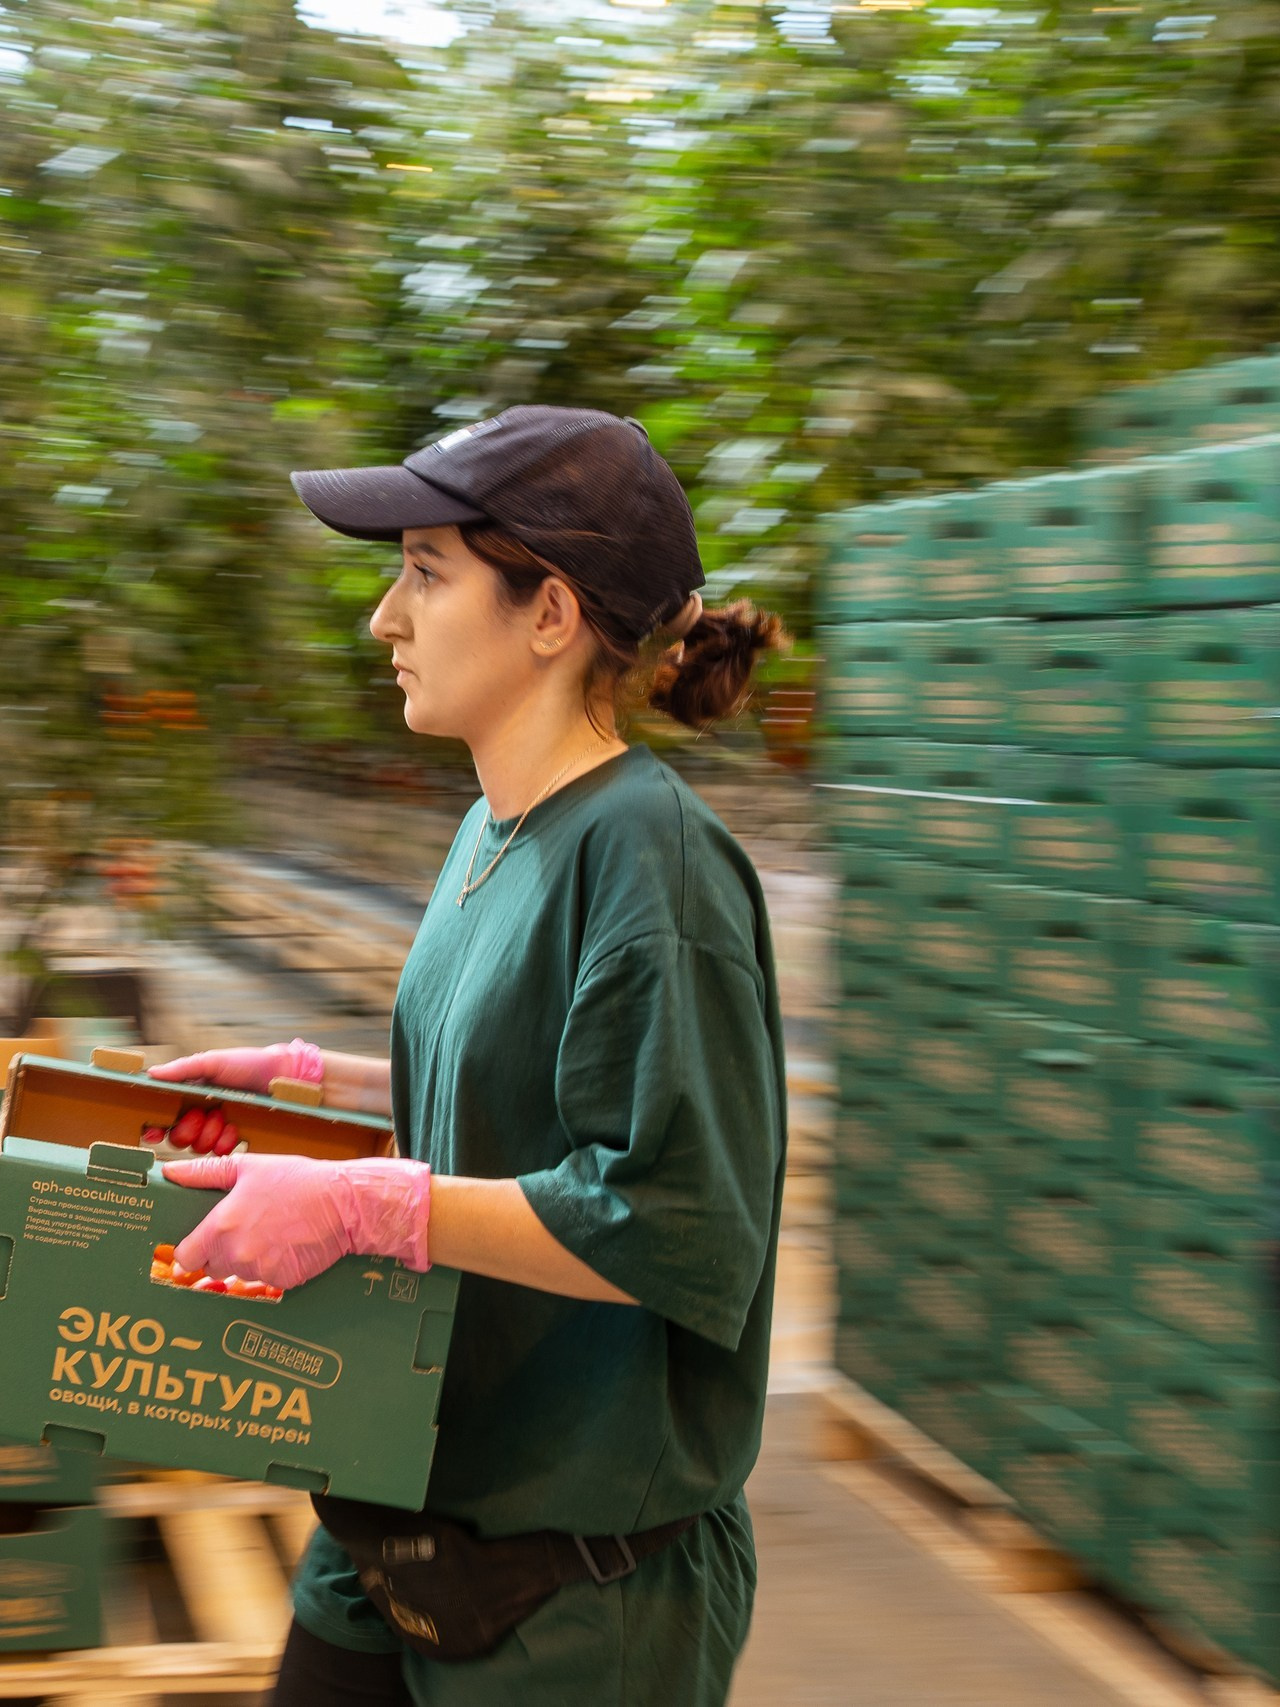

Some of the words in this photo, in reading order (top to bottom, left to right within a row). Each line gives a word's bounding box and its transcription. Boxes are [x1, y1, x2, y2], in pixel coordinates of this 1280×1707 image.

[32, 1180, 154, 1209] aph-ecoculture.ru
[28, 1205, 68, 1218] Выращено
[74, 1214, 123, 1228] защищенном
[123, 1222, 148, 1232] грунте
[30, 1196, 57, 1207] Страна
[118, 1210, 152, 1222] РОССИЯ
[24, 1223, 81, 1238] рекомендуется
[81, 1233, 100, 1241] мыть
[26, 1215, 50, 1226] Перед
[51, 1220, 108, 1235] употреблением
[23, 1232, 34, 1240] Не
[34, 1235, 70, 1246] содержит
[71, 1240, 90, 1249] ГМО
[51, 1346, 313, 1426] КУЛЬТУРА
[49, 1387, 122, 1415] овощи,
[127, 1401, 140, 1415] в
[144, 1404, 232, 1431] которых
[234, 1419, 312, 1446] уверен
